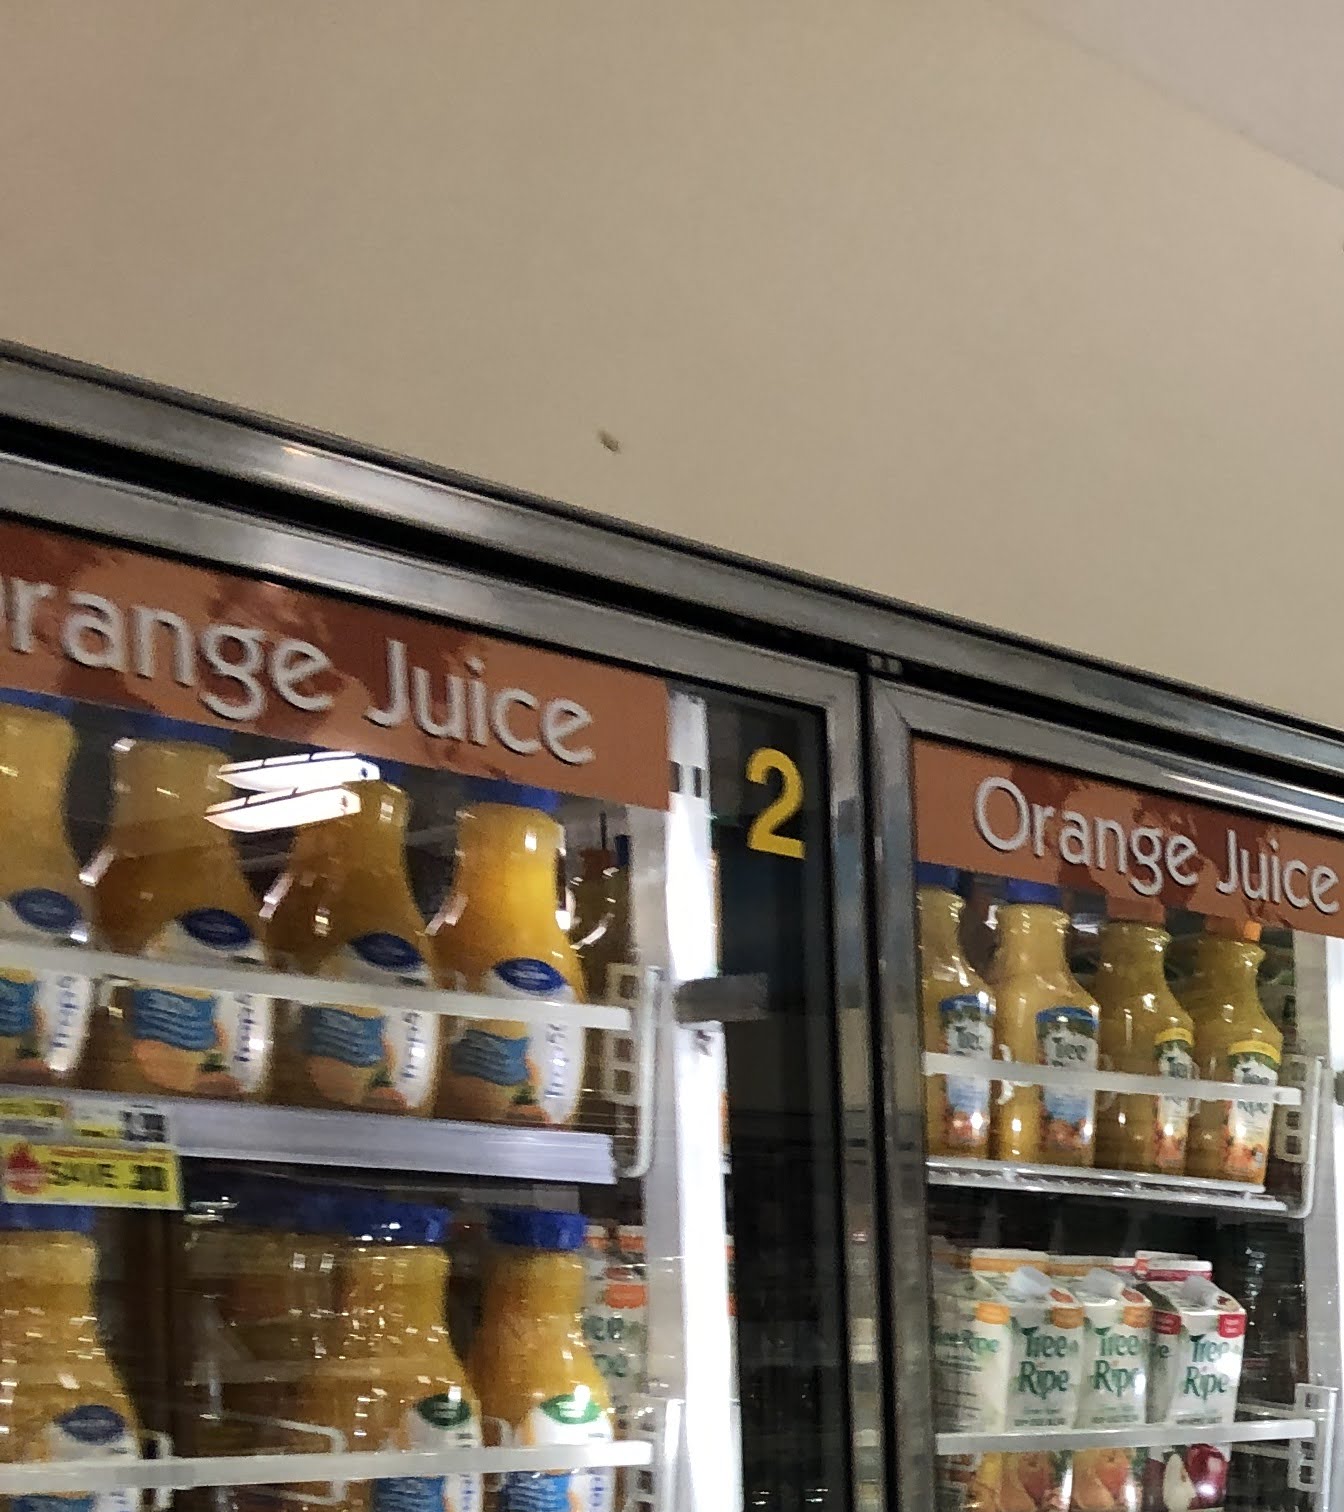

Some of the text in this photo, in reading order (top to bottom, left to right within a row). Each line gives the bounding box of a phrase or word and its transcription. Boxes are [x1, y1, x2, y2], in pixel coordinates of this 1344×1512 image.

[0, 576, 597, 766] range Juice
[746, 746, 806, 860] 2
[975, 775, 1339, 914] Orange Juice
[1022, 1327, 1067, 1357] Tree
[1095, 1327, 1139, 1356] Tree
[1189, 1334, 1229, 1362] Tree
[1018, 1360, 1070, 1399] Ripe
[1183, 1365, 1229, 1402] Ripe
